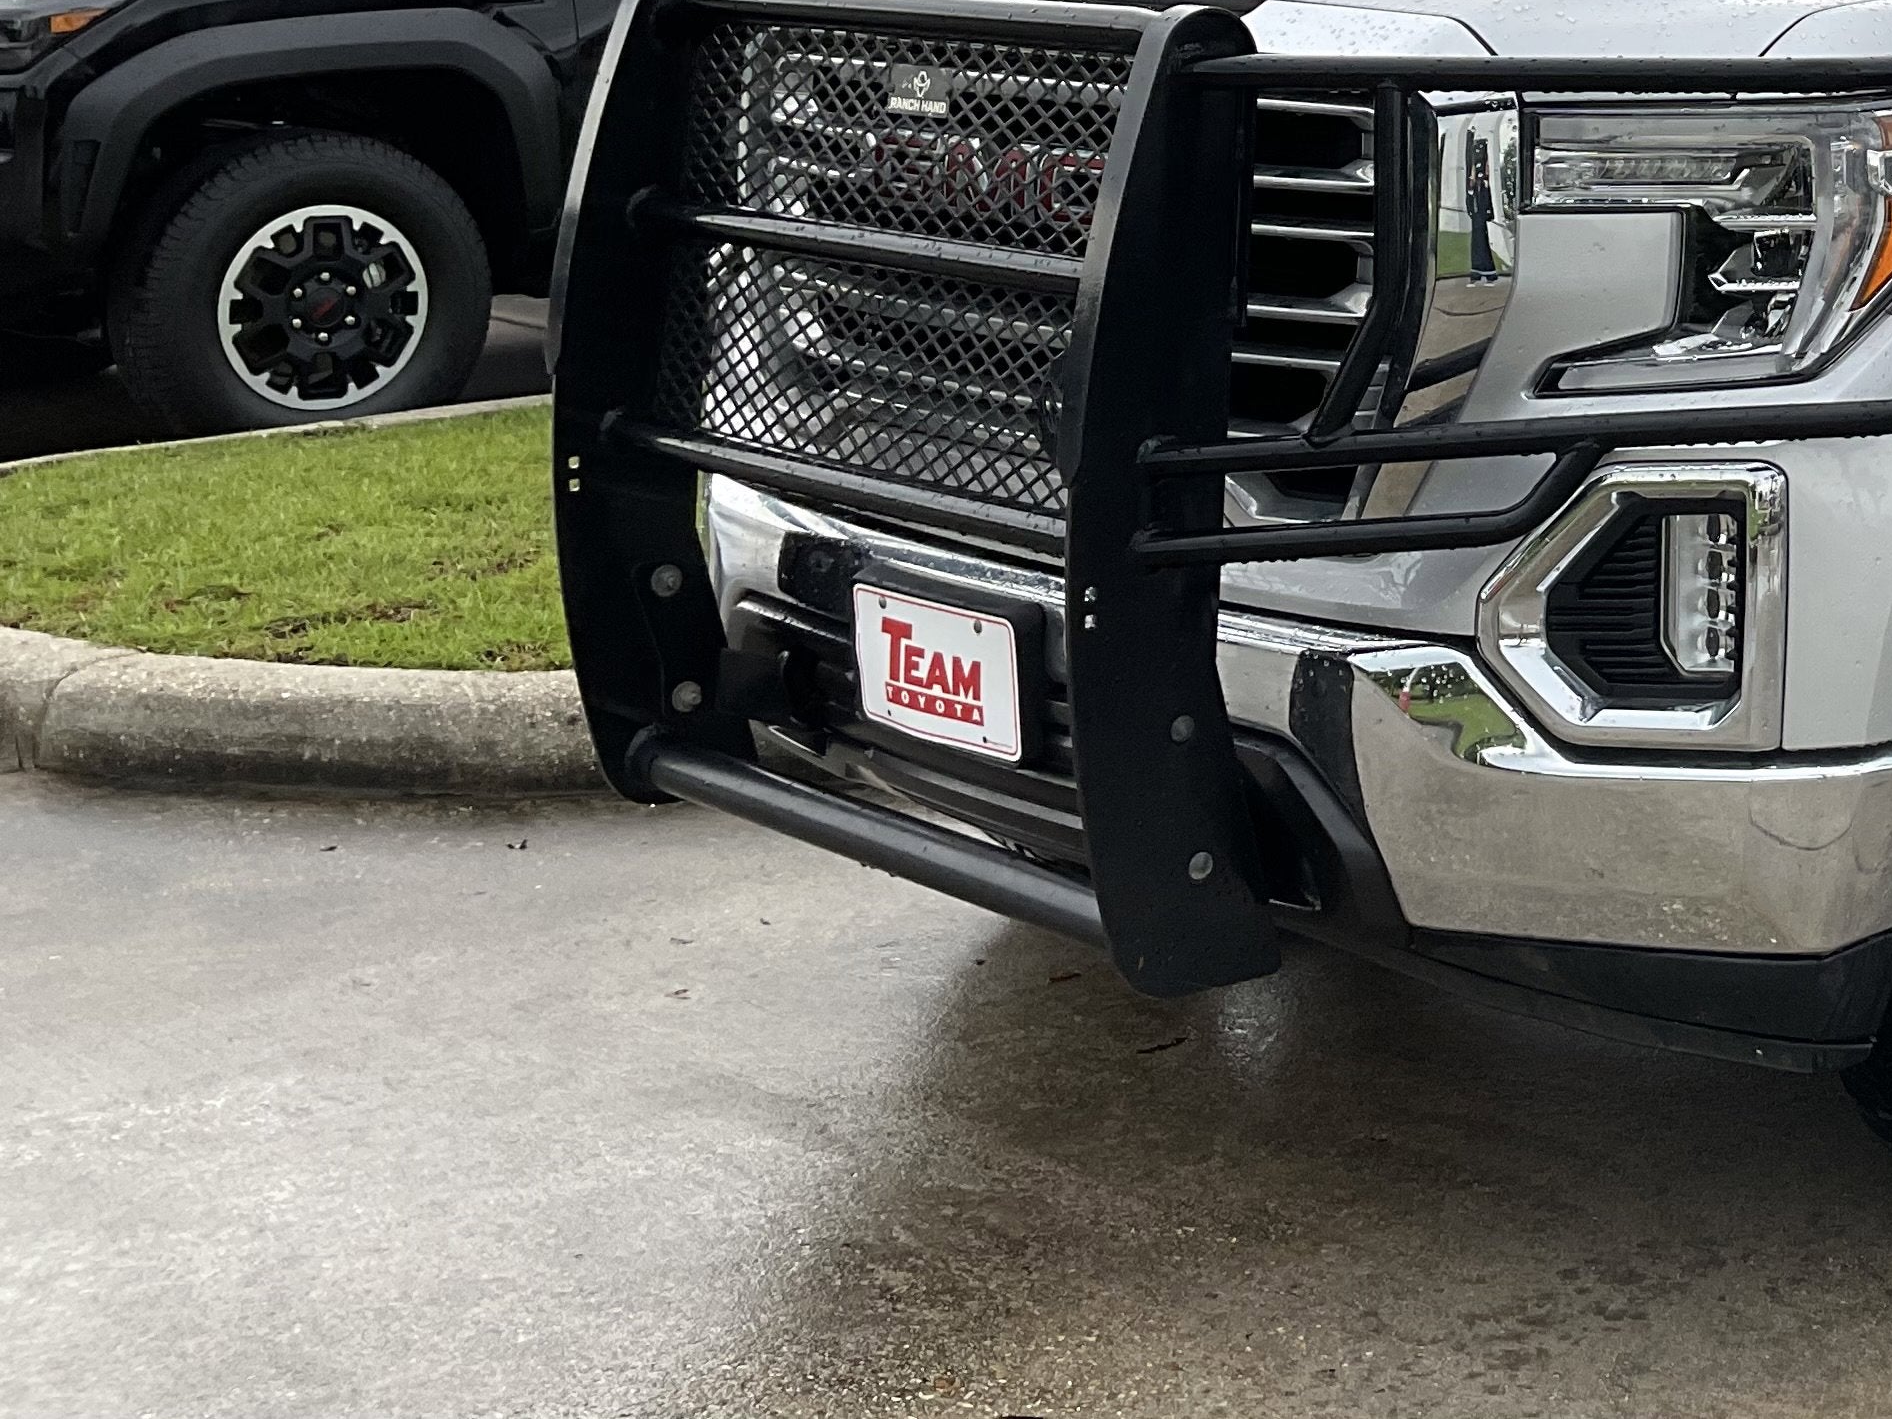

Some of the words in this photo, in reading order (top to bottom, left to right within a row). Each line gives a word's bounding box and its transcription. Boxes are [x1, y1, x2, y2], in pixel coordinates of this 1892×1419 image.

[889, 95, 921, 112] RANCH
[921, 99, 947, 114] HAND
[881, 616, 982, 702] TEAM
[886, 685, 981, 722] TOYOTA
